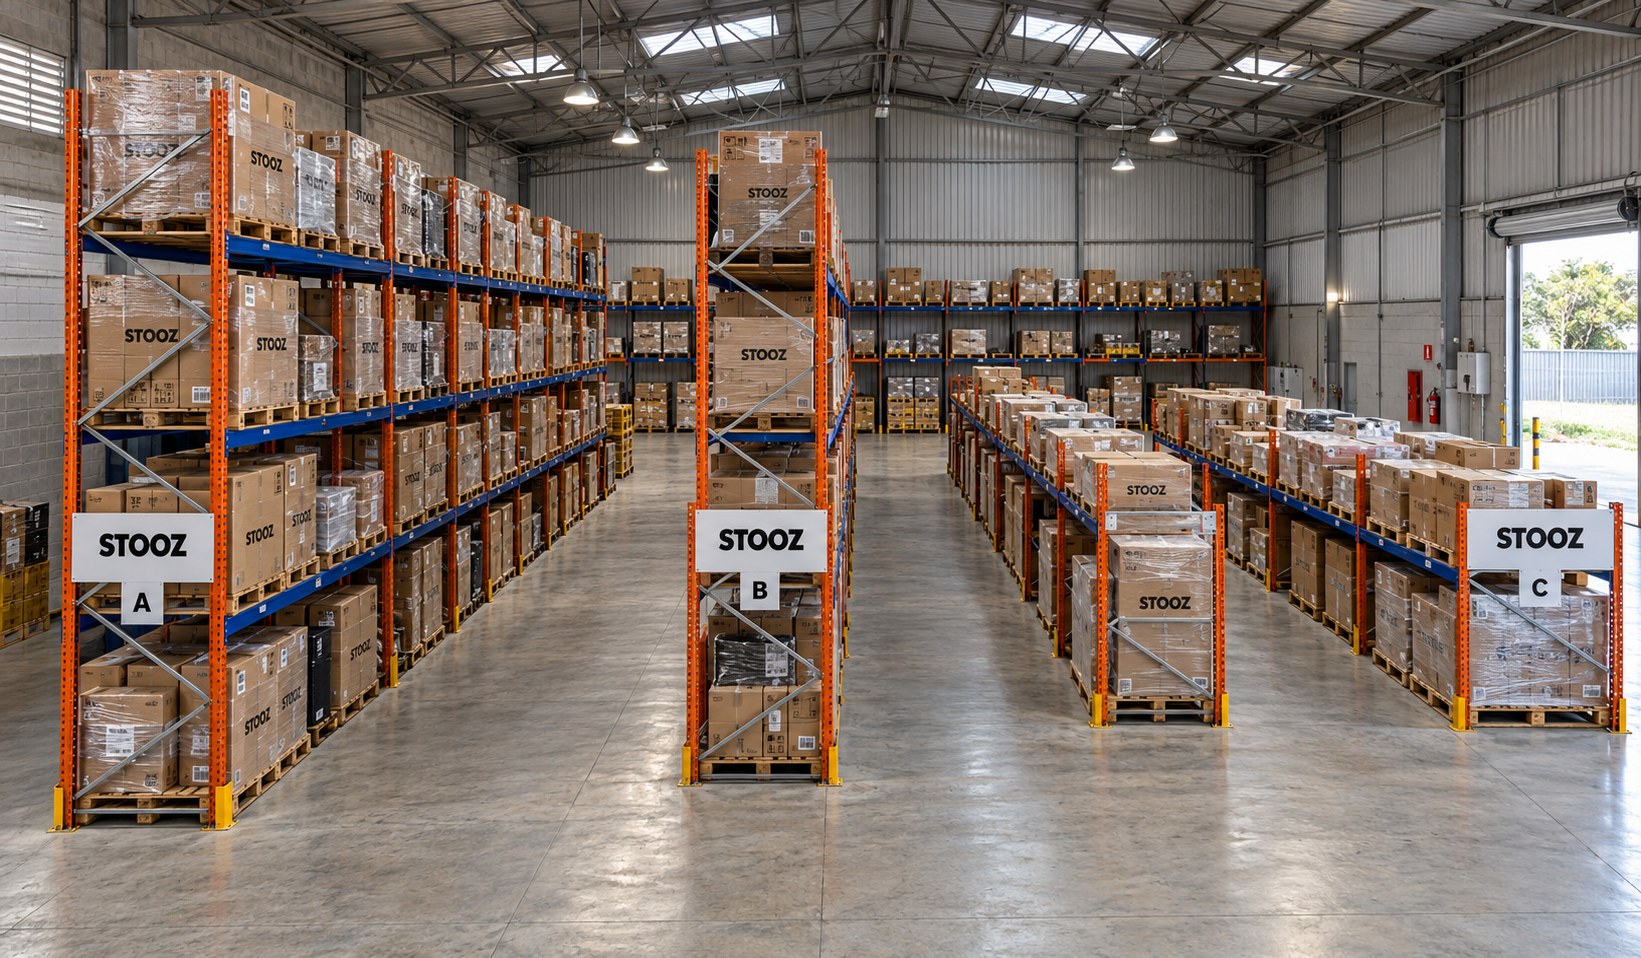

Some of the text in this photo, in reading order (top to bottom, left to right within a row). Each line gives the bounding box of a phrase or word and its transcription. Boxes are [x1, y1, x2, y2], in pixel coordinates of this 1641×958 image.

[251, 150, 283, 173] STOOZ
[748, 188, 788, 199] STOOZ
[125, 328, 179, 343] STOOZ
[256, 337, 288, 351] STOOZ
[740, 348, 787, 361] STOOZ
[1126, 485, 1166, 496] STOOZ
[292, 509, 312, 528] STOOZ
[245, 524, 274, 546] STOOZ
[718, 528, 804, 551] STOOZ
[1496, 527, 1584, 549] STOOZ
[99, 533, 187, 557] STOOZ
[752, 581, 768, 600] B
[1531, 578, 1549, 597] C
[132, 592, 152, 613] A
[1139, 596, 1191, 610] STOOZ
[350, 638, 371, 662] STOOZ
[244, 707, 271, 736] STOOZ
